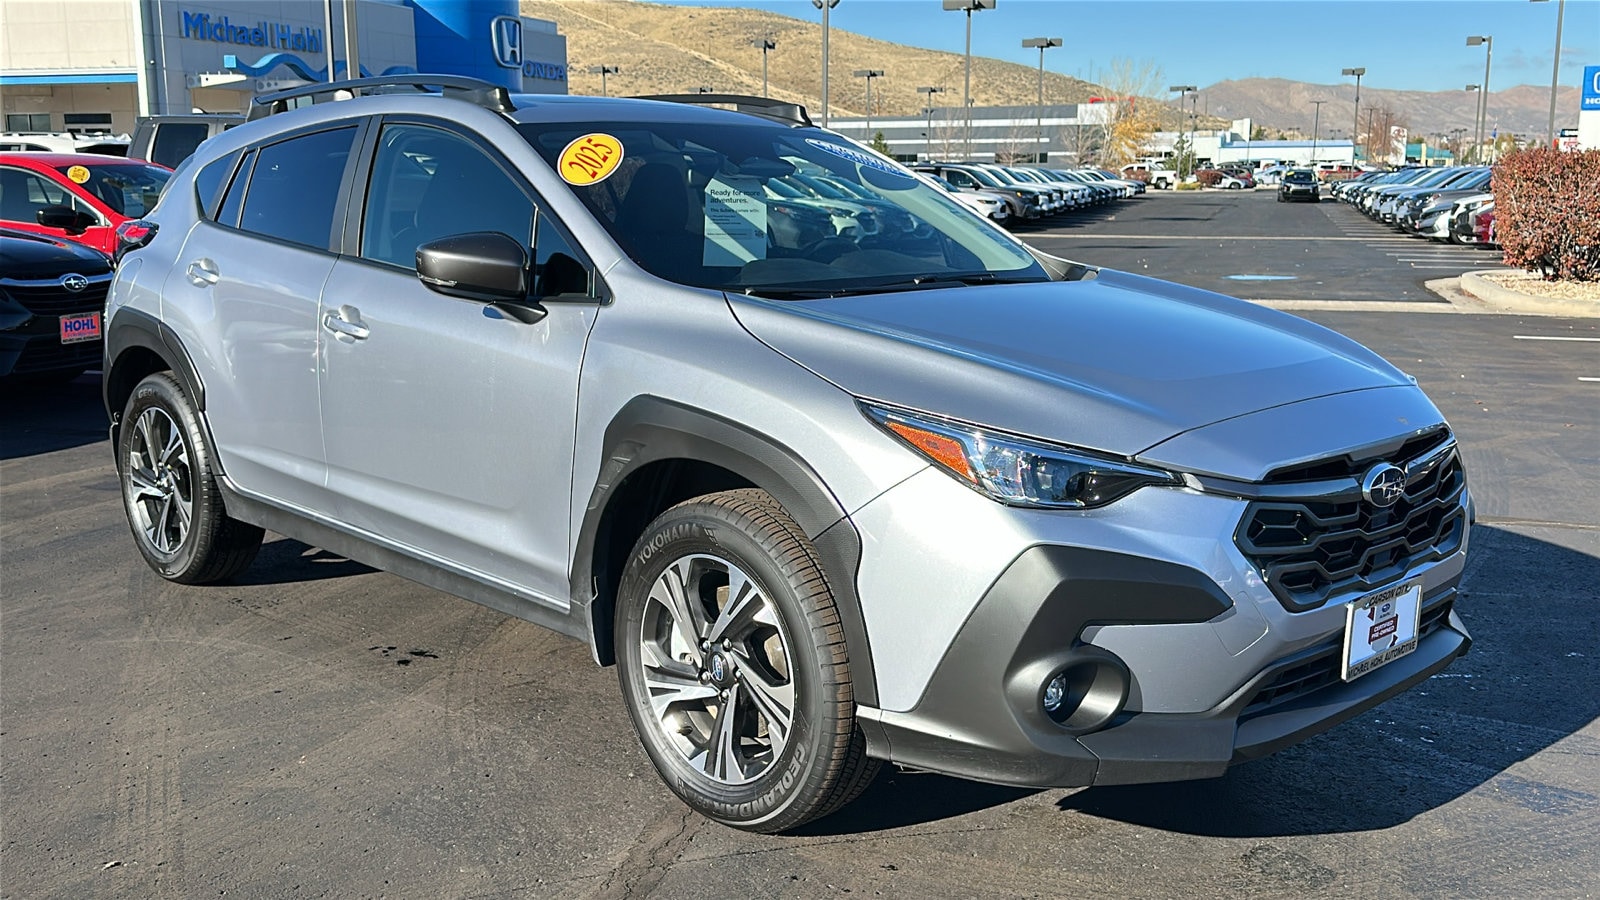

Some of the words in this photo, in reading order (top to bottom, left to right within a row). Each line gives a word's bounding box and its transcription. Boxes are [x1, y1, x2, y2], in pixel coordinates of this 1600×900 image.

[183, 11, 269, 46] Michael
[275, 23, 323, 53] Hohl
[523, 61, 566, 81] ONDA
[568, 137, 613, 179] 2025
[64, 319, 97, 332] HOHL
[637, 522, 701, 565] YOKOHAMA
[713, 742, 806, 817] GEOLANDAR
